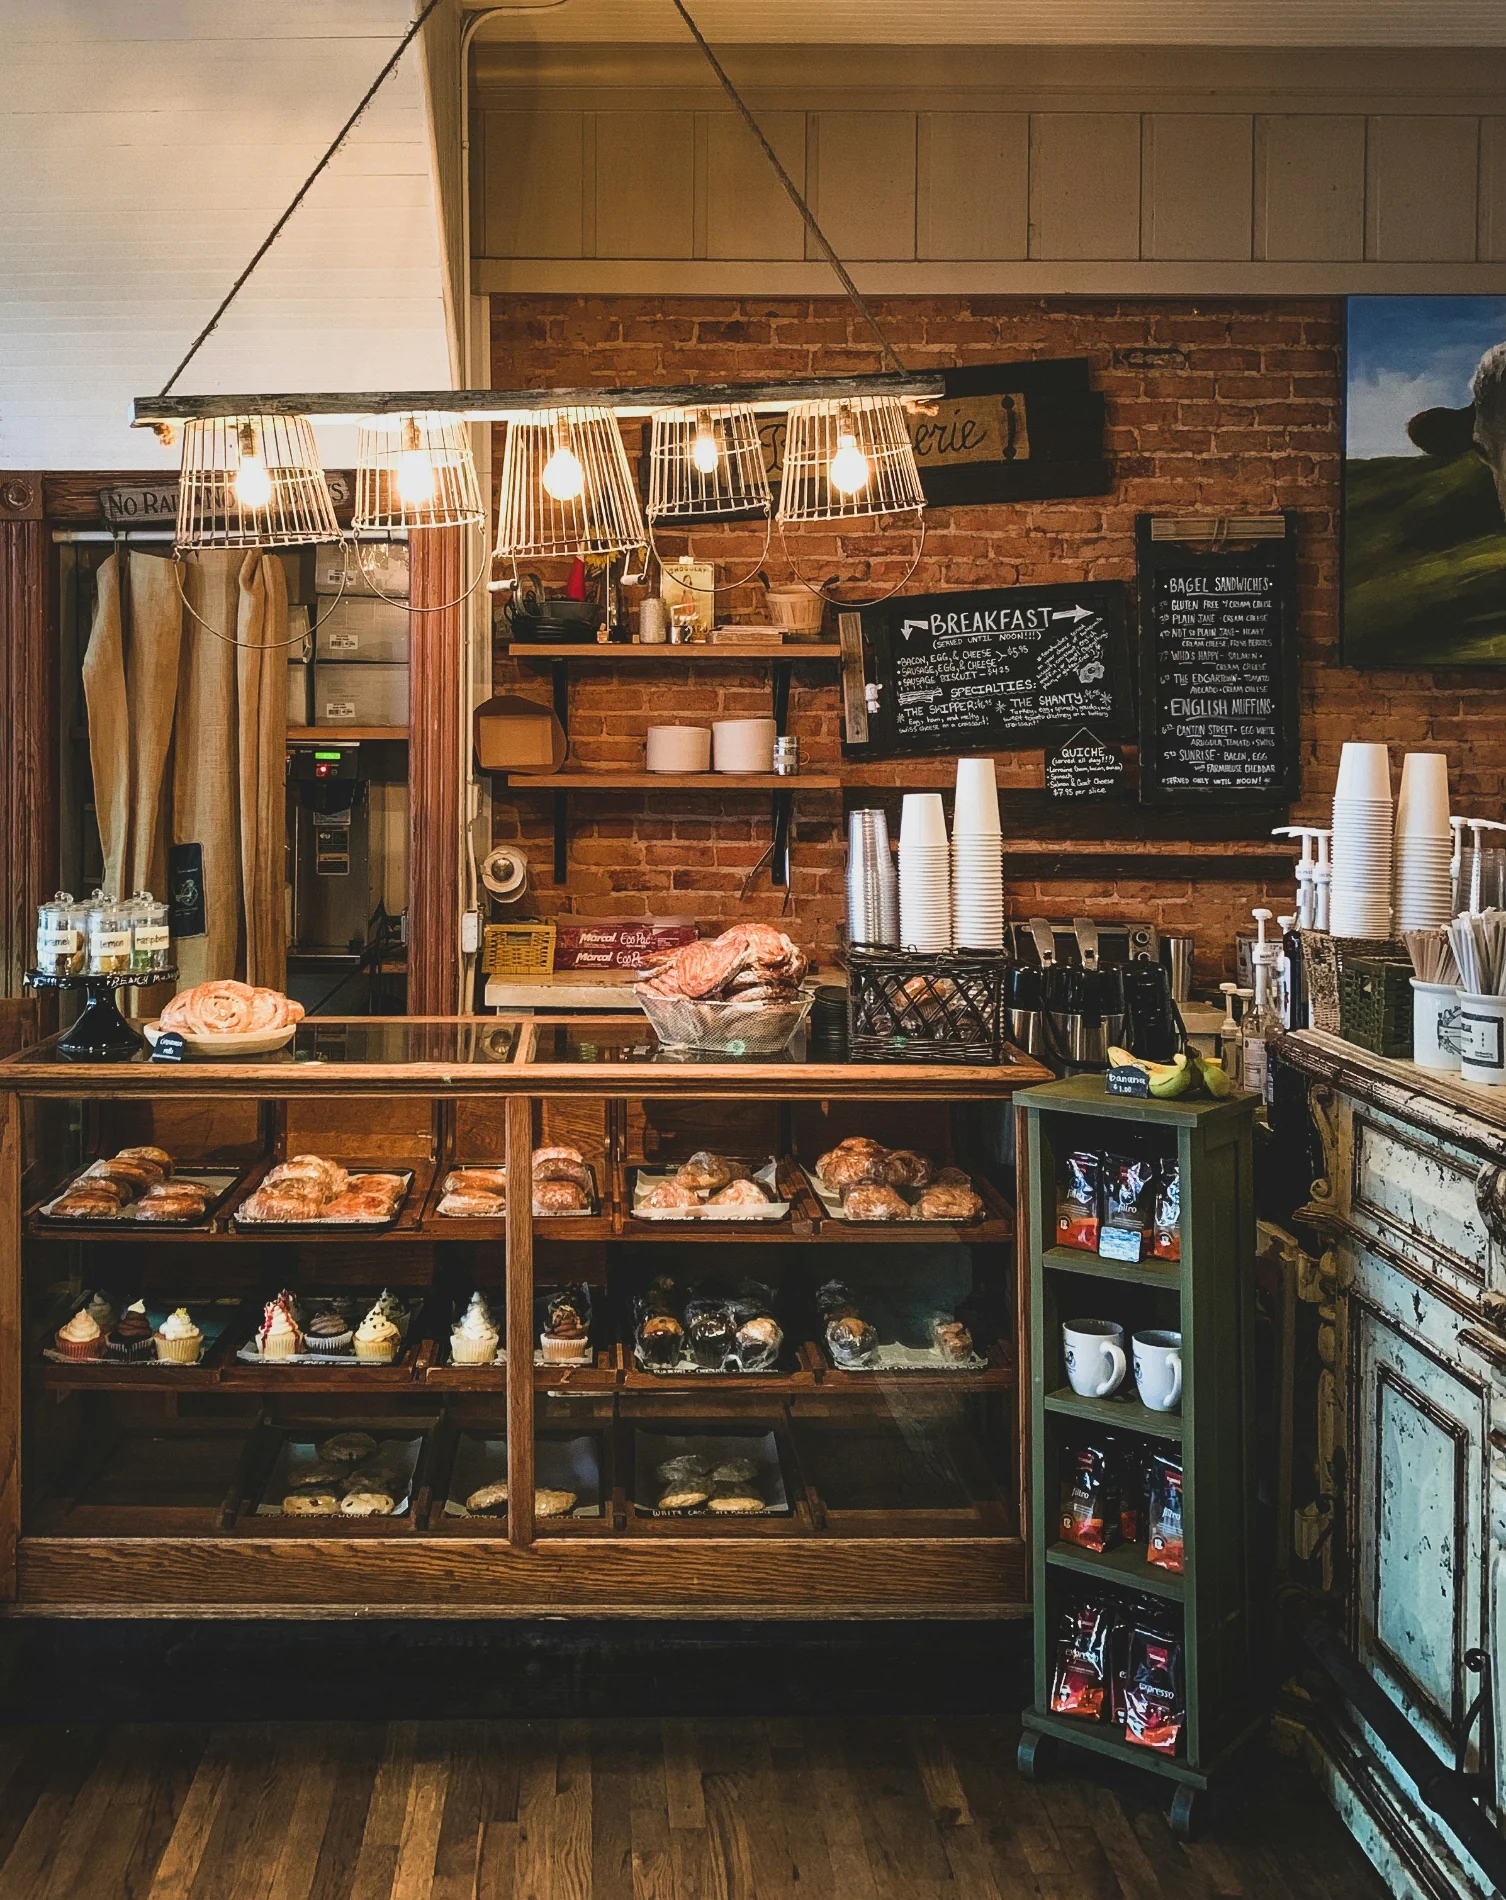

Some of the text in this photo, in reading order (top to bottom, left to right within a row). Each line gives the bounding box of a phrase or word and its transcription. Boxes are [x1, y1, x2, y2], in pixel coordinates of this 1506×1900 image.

[108, 493, 137, 516] NO
[1170, 577, 1268, 593] BAGEL SANDWICHES
[1172, 600, 1198, 611] GLUTEN
[1204, 600, 1219, 609] FREE
[930, 608, 1052, 636] BREAKFAST
[1172, 614, 1195, 624] PLAIN
[1198, 614, 1215, 623] JANE
[1172, 628, 1186, 637] NOT
[1197, 628, 1216, 637] PLAIN
[933, 639, 962, 649] (SERVED
[962, 649, 992, 660] CHEESE
[1171, 651, 1195, 660] WHO'S
[1228, 652, 1257, 660] SALMON
[968, 659, 998, 670] CHEESE
[902, 676, 936, 686] SAUSAGE
[940, 671, 978, 683] BISCUIT
[1174, 674, 1188, 684] THE
[950, 679, 1036, 698] SPECIALTIES:
[1010, 697, 1032, 707] THE
[1171, 698, 1271, 716] ENGLISH MUFFINS
[904, 706, 924, 716] THE
[1240, 726, 1254, 735] EGG
[1062, 747, 1106, 757] QUICHE
[1245, 765, 1276, 773] CHEDDAR
[579, 932, 616, 944] Marcal
[100, 940, 124, 949] lemon
[576, 952, 612, 963] Marcal
[1108, 1073, 1146, 1085] banana
